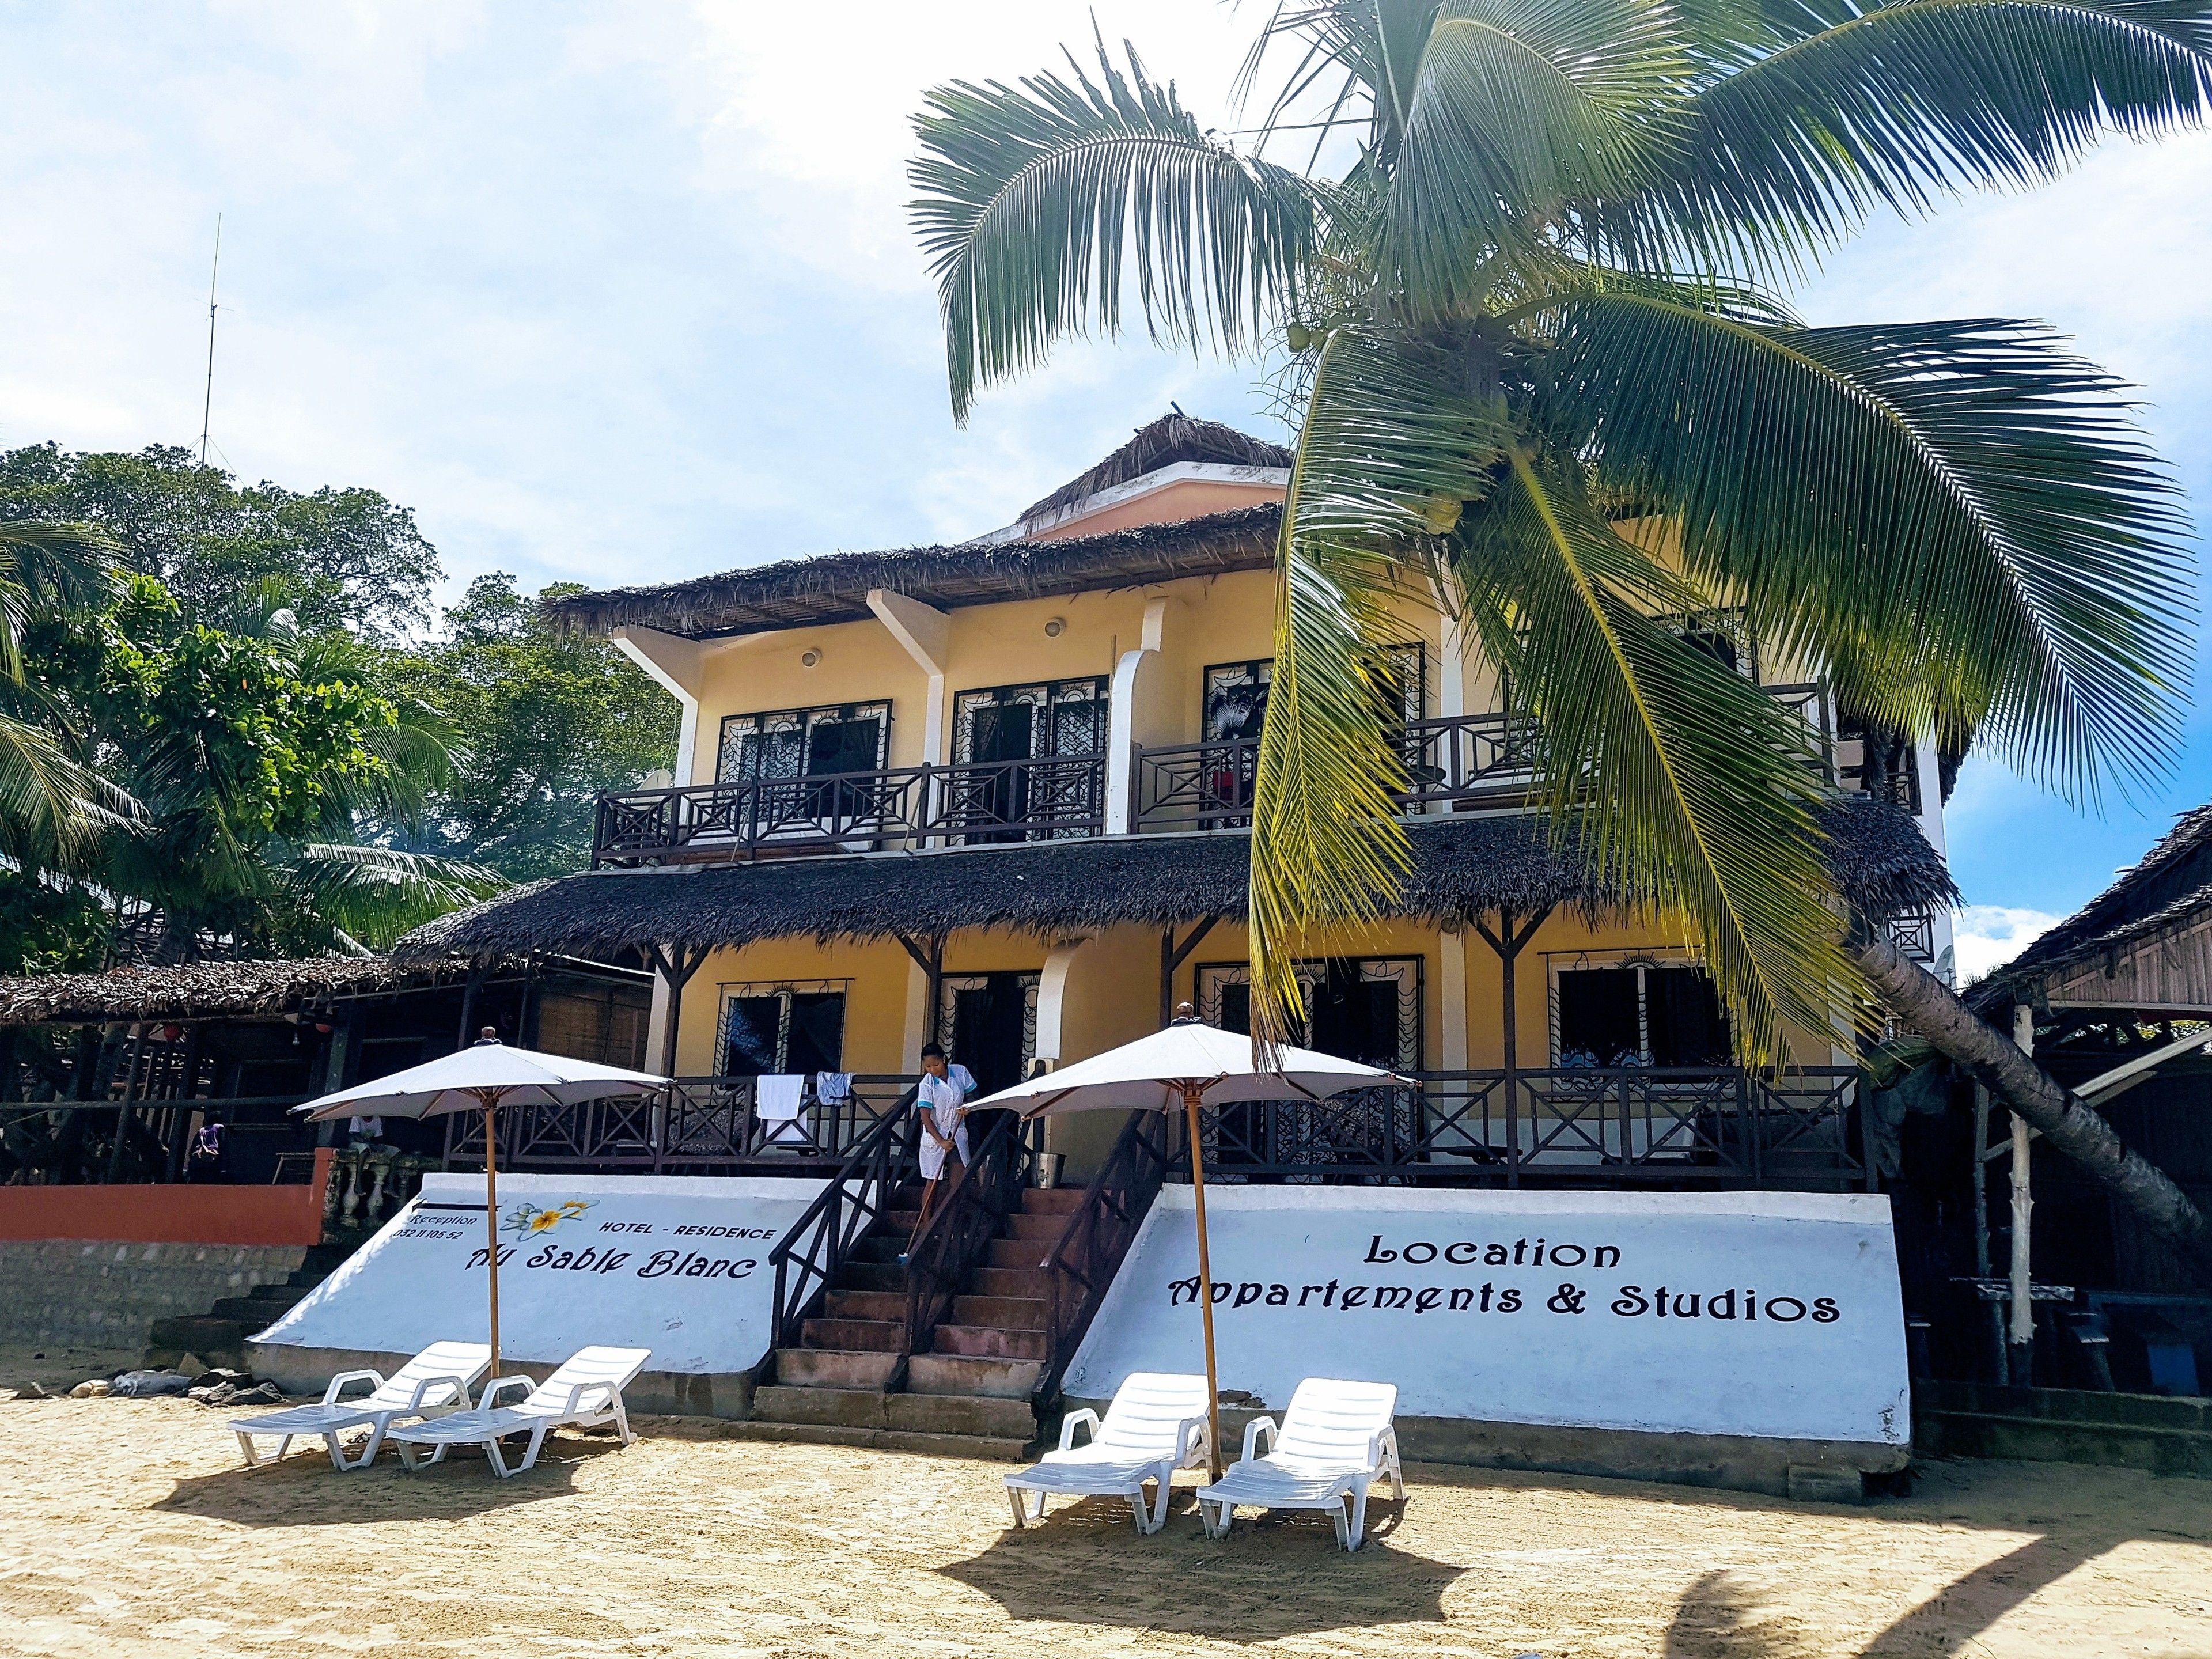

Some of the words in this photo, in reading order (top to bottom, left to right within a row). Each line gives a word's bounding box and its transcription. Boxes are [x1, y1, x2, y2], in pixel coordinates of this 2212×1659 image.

[410, 1214, 478, 1225] Reception
[599, 1221, 653, 1233] HOTEL
[673, 1225, 777, 1240] RESIDENCE
[393, 1229, 416, 1237] 032
[415, 1229, 427, 1237] 11
[425, 1230, 447, 1238] 105
[465, 1243, 517, 1270] Au
[527, 1244, 632, 1274] Sable
[637, 1249, 757, 1279] Blanc
[1363, 1234, 1621, 1268] Location
[1168, 1275, 1522, 1314] Appartements
[1547, 1283, 1586, 1315] &
[1611, 1285, 1841, 1323] Studios
